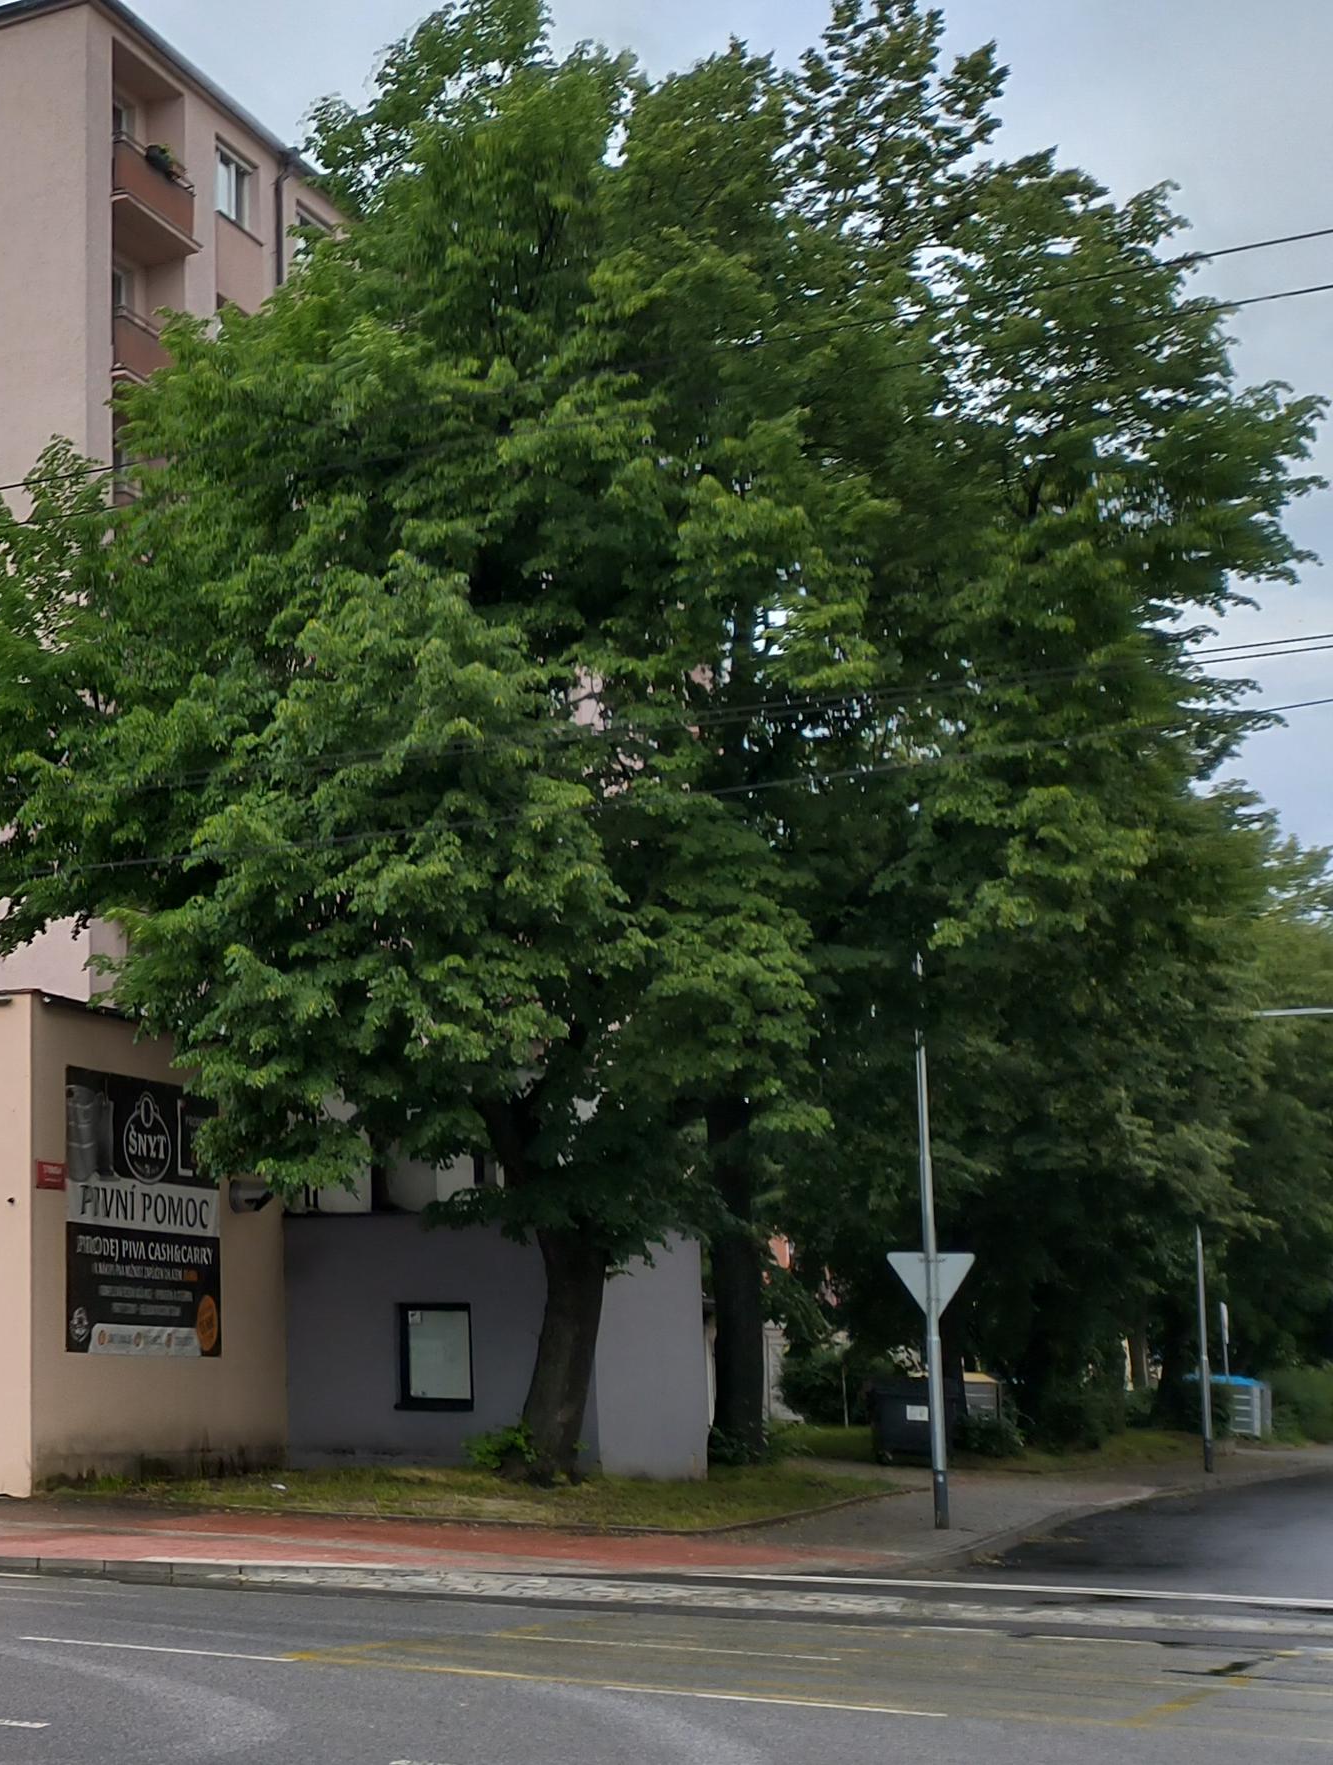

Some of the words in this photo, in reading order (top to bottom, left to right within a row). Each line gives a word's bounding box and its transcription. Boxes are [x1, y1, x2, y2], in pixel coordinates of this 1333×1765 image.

[128, 1124, 167, 1160] ŠNYT
[79, 1184, 136, 1222] PIVNÍ
[141, 1192, 210, 1230] POMOC
[121, 1239, 147, 1260] PIVA
[147, 1242, 214, 1265] CASH&CARRY
